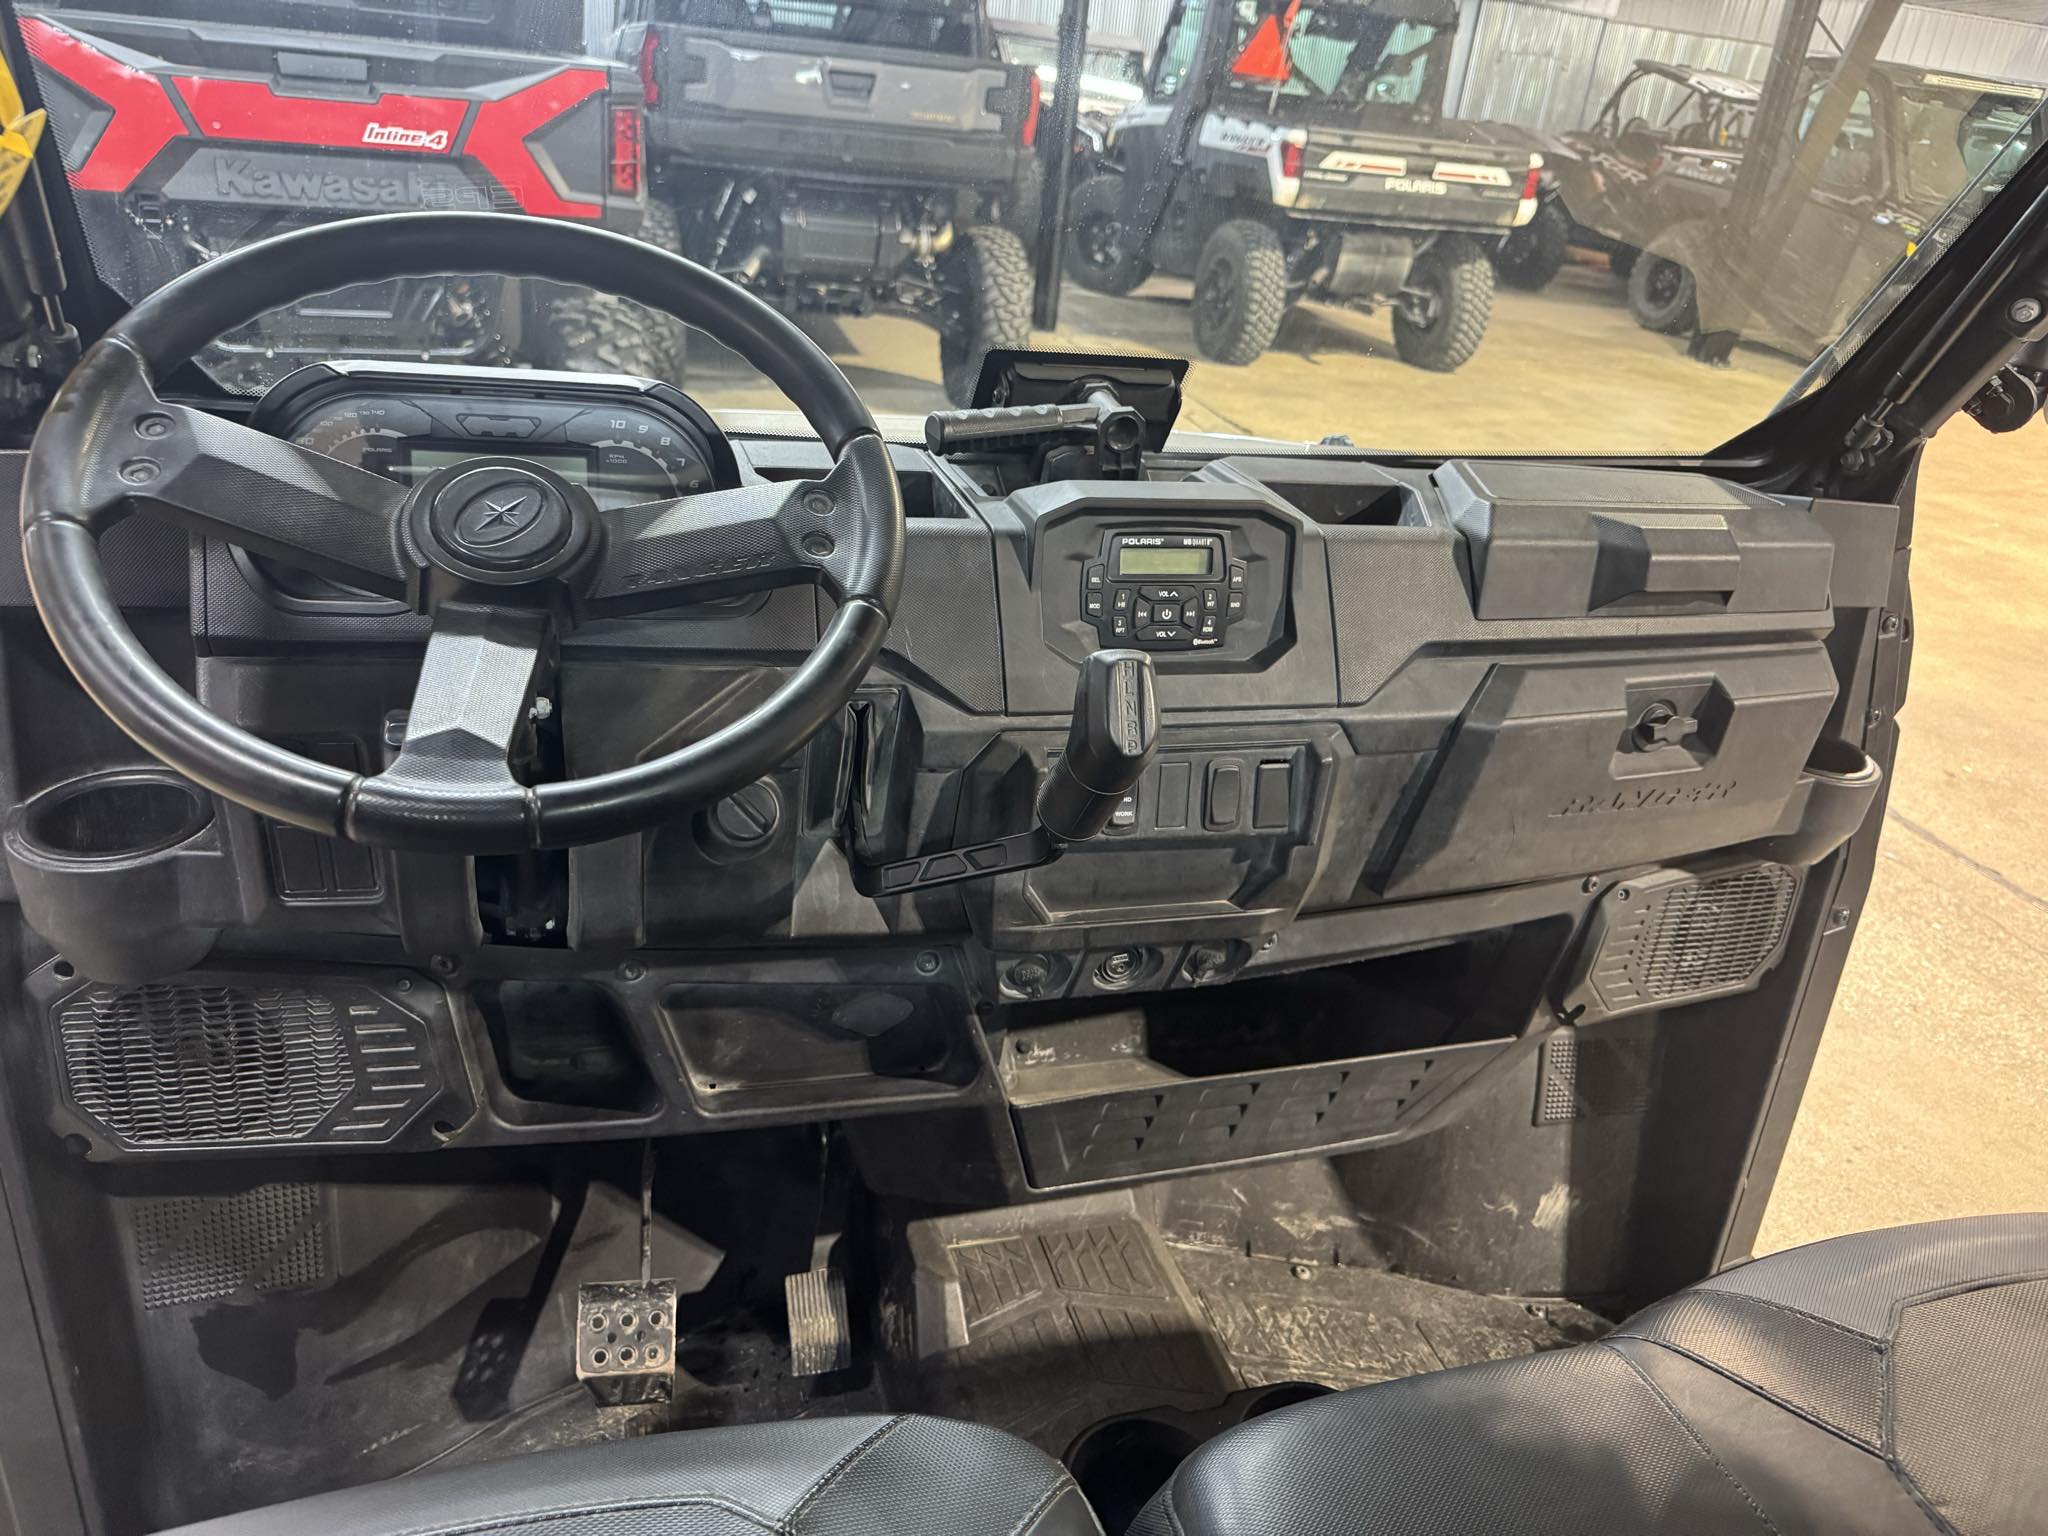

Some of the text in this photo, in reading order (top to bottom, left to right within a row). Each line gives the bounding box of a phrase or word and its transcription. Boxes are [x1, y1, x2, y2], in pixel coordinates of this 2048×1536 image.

[1384, 176, 1448, 196] POLARIS
[610, 419, 627, 429] 10
[638, 425, 649, 434] 9
[660, 436, 672, 446] 8
[676, 457, 686, 468] 7
[689, 479, 700, 489] 6
[1158, 590, 1170, 598] VOL
[1155, 630, 1168, 639] VOL
